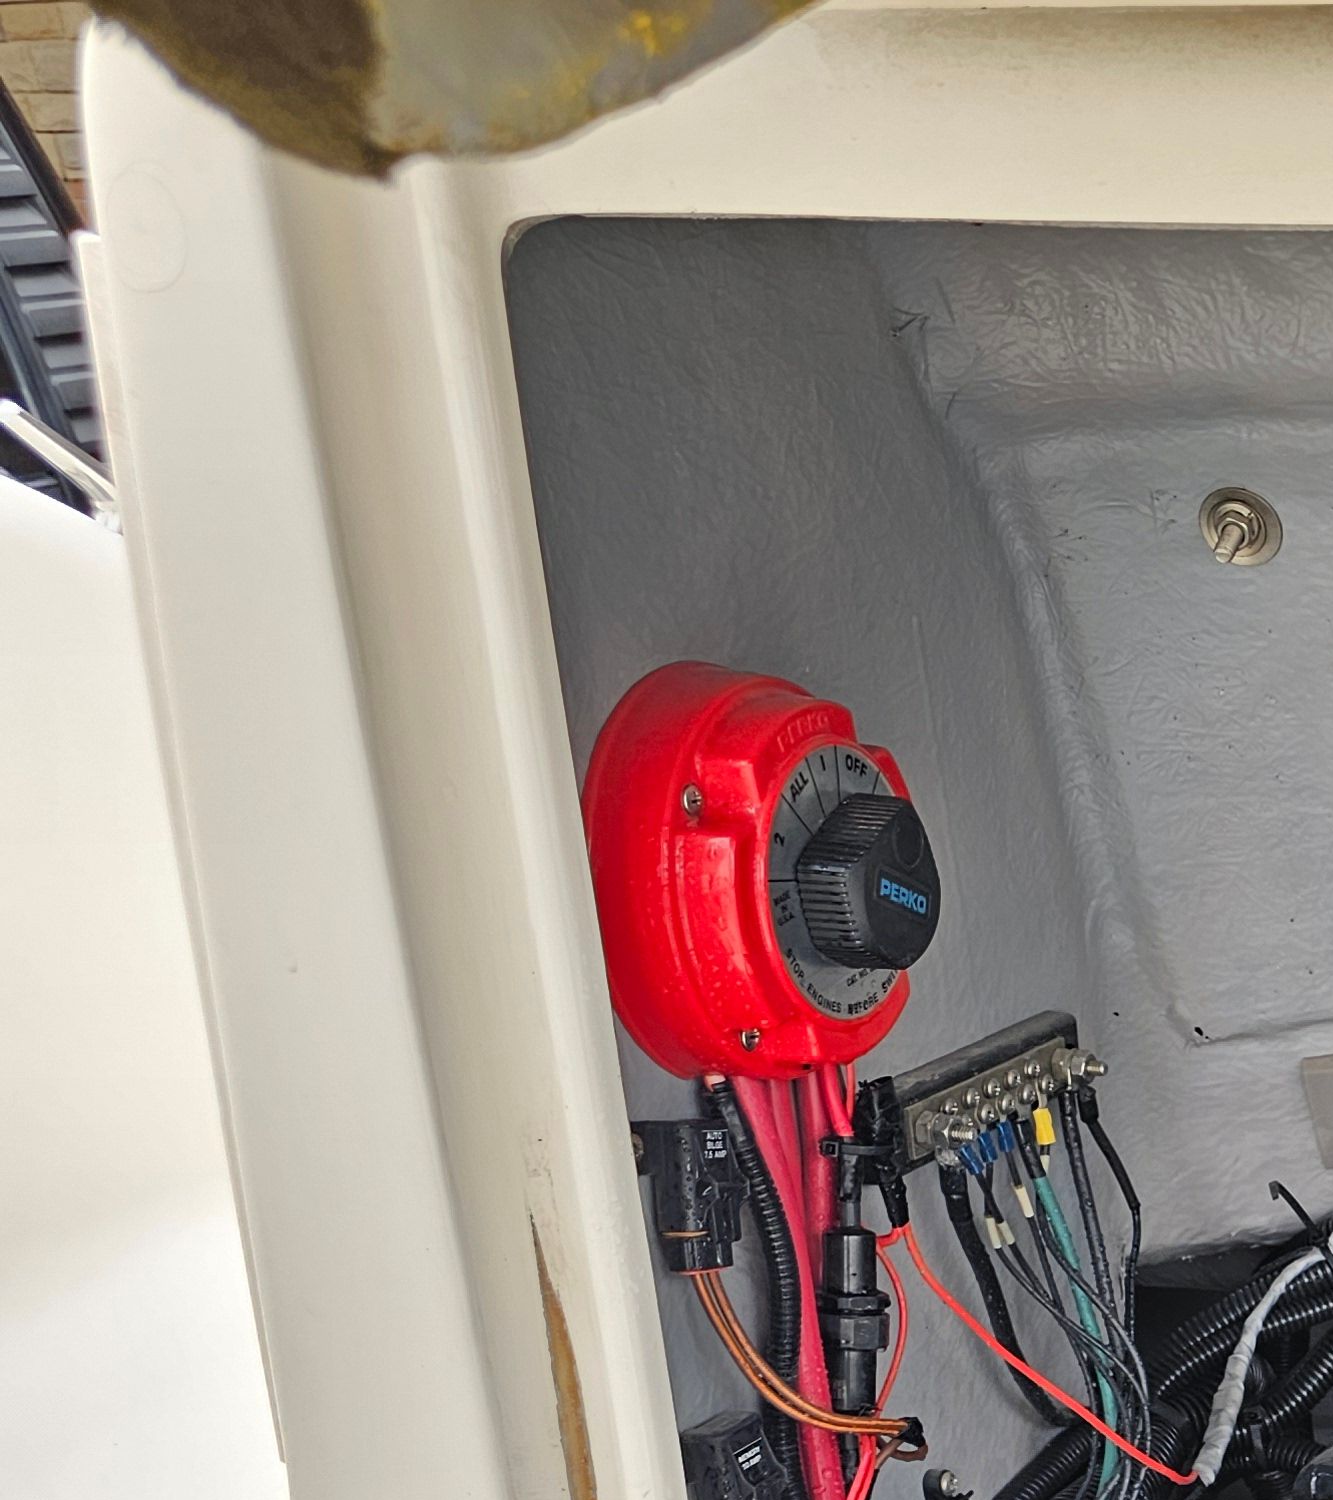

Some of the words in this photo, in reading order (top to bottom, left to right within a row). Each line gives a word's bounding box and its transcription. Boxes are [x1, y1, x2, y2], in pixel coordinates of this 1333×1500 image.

[845, 754, 868, 777] OFF
[789, 772, 809, 803] ALL
[773, 831, 786, 847] 2
[879, 878, 927, 916] PERKO
[785, 947, 805, 980] STOP
[806, 981, 842, 1014] ENGINES
[705, 1130, 724, 1141] AUTO
[705, 1140, 724, 1150] BILGE
[714, 1149, 728, 1158] AMP
